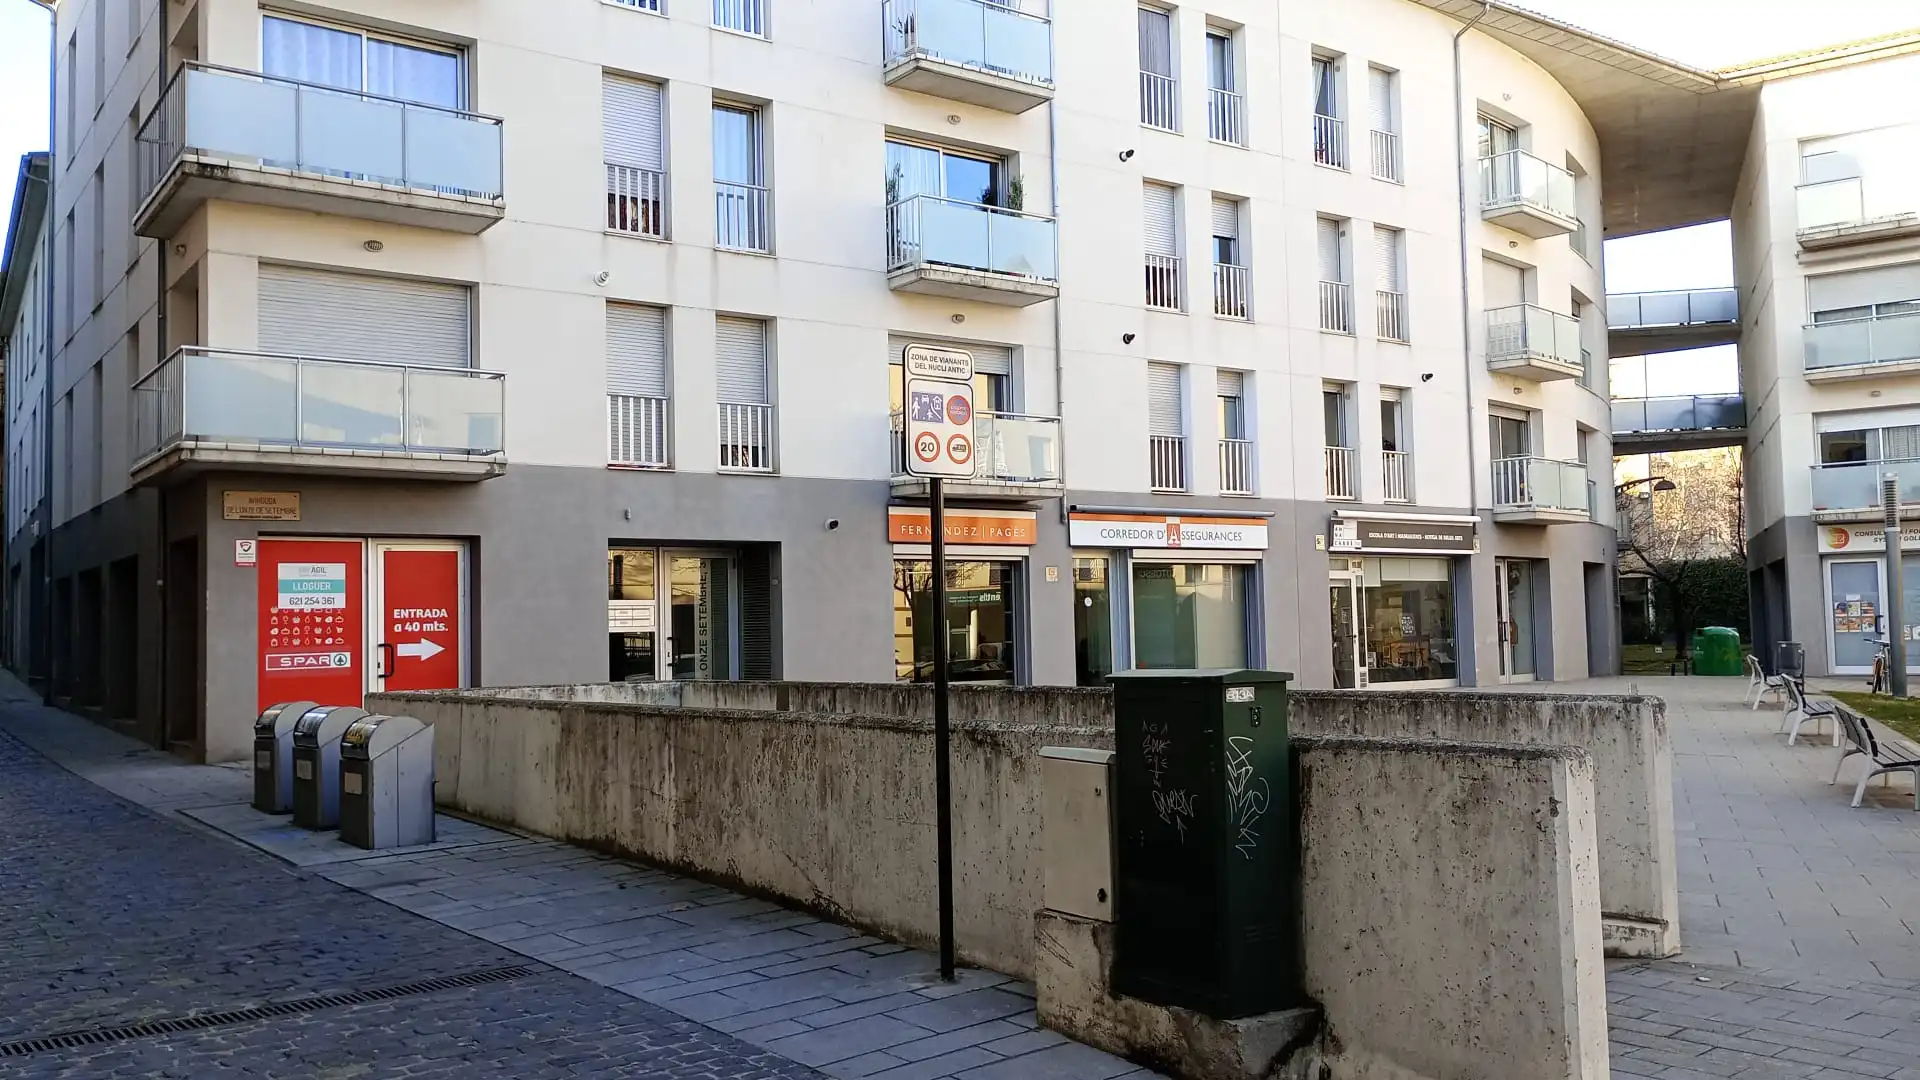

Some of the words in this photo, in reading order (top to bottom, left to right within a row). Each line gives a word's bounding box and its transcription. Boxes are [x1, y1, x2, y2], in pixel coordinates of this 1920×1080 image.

[911, 353, 928, 361] ZONA
[929, 355, 939, 363] DE
[939, 356, 969, 366] VIANANTS
[915, 362, 928, 370] DEL
[928, 364, 946, 372] NUCLI
[947, 365, 966, 374] ANTIC
[920, 441, 935, 452] 20
[901, 524, 977, 537] FERNNDEZ
[1100, 528, 1154, 540] CORREDOR
[700, 560, 707, 569] 3
[292, 581, 331, 591] LLOGUER
[289, 597, 302, 605] 621
[304, 597, 320, 605] 254
[321, 597, 335, 605] 361
[699, 571, 708, 636] SETEMBRE,
[393, 608, 448, 618] ENTRADA
[394, 623, 402, 632] a
[404, 621, 420, 632] 40
[423, 620, 448, 632] mts.
[280, 655, 331, 667] SPAR
[700, 639, 708, 671] ONZE
